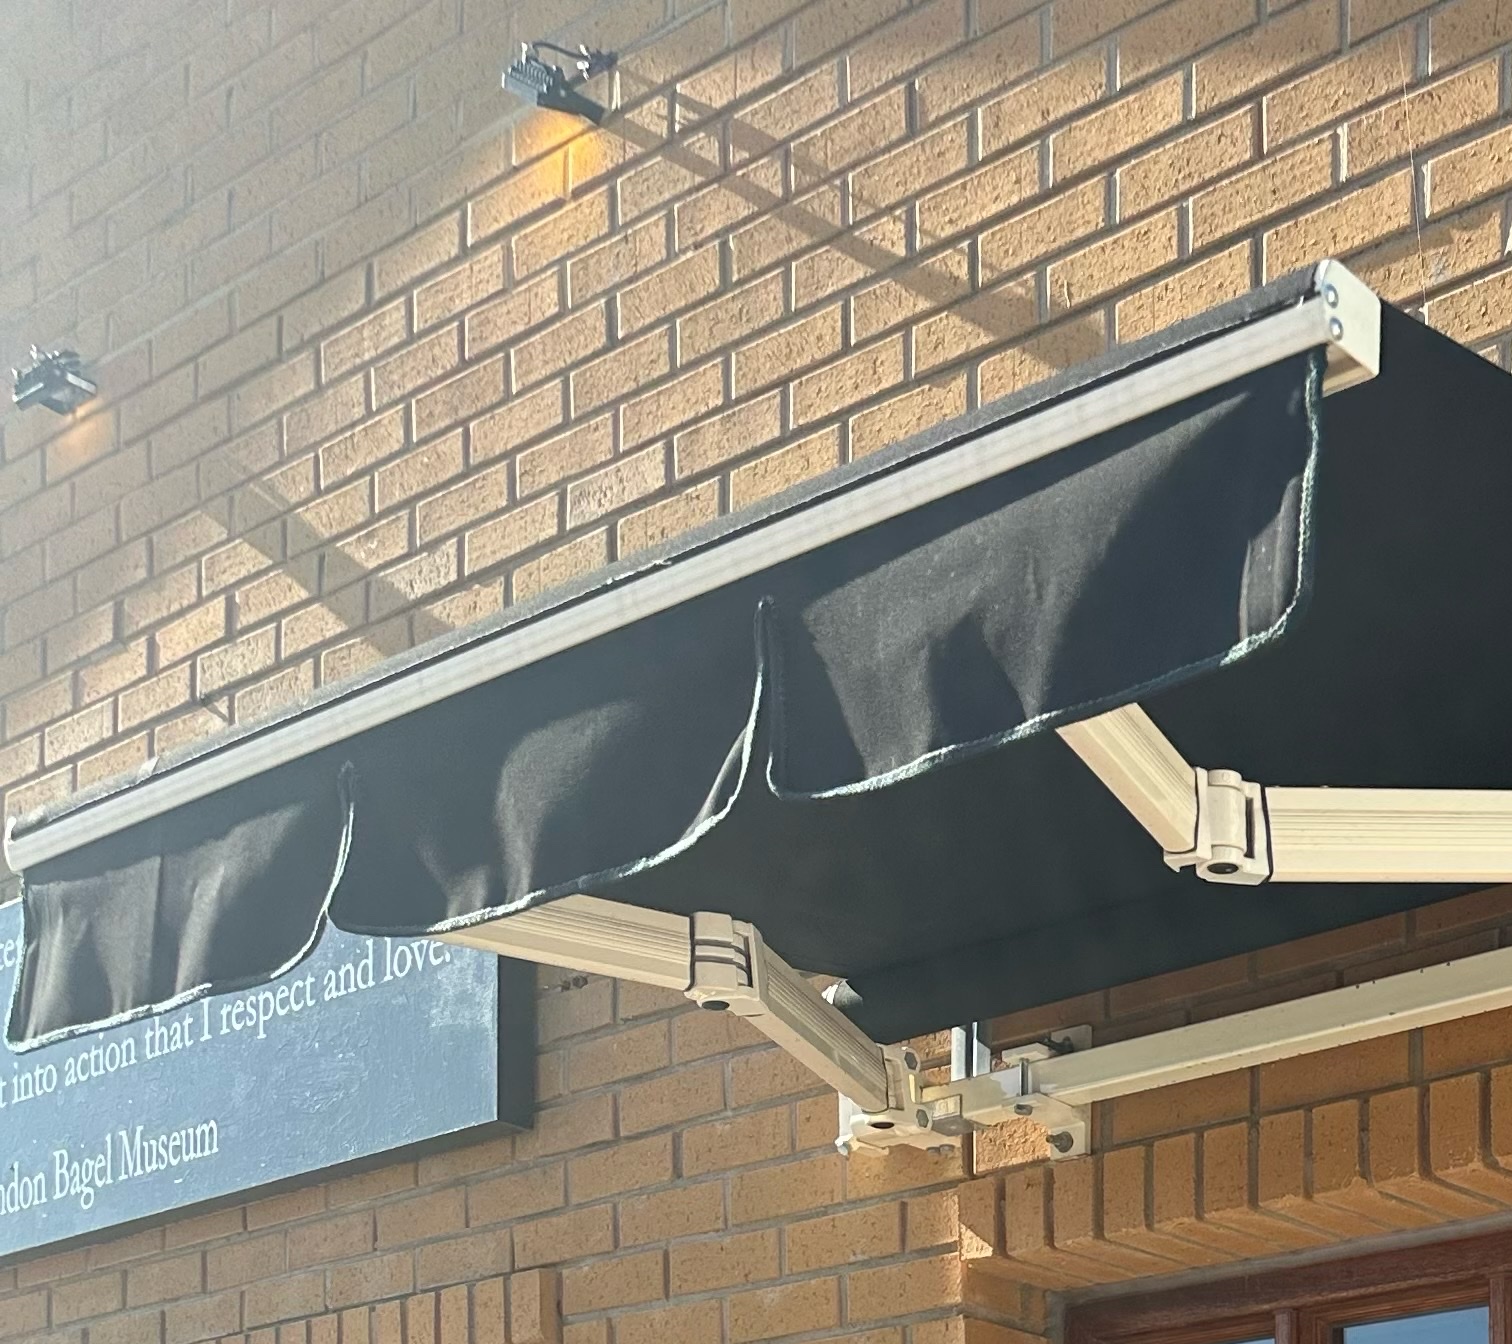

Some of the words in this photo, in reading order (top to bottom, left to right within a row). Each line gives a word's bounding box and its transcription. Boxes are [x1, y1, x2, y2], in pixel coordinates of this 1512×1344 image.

[12, 1062, 58, 1104] into
[64, 1033, 137, 1087] action
[145, 1013, 194, 1060] that
[200, 998, 213, 1042] I
[220, 972, 316, 1040] respect
[323, 938, 376, 1002] and
[53, 1133, 114, 1210] Bagel
[118, 1119, 219, 1181] Museum
